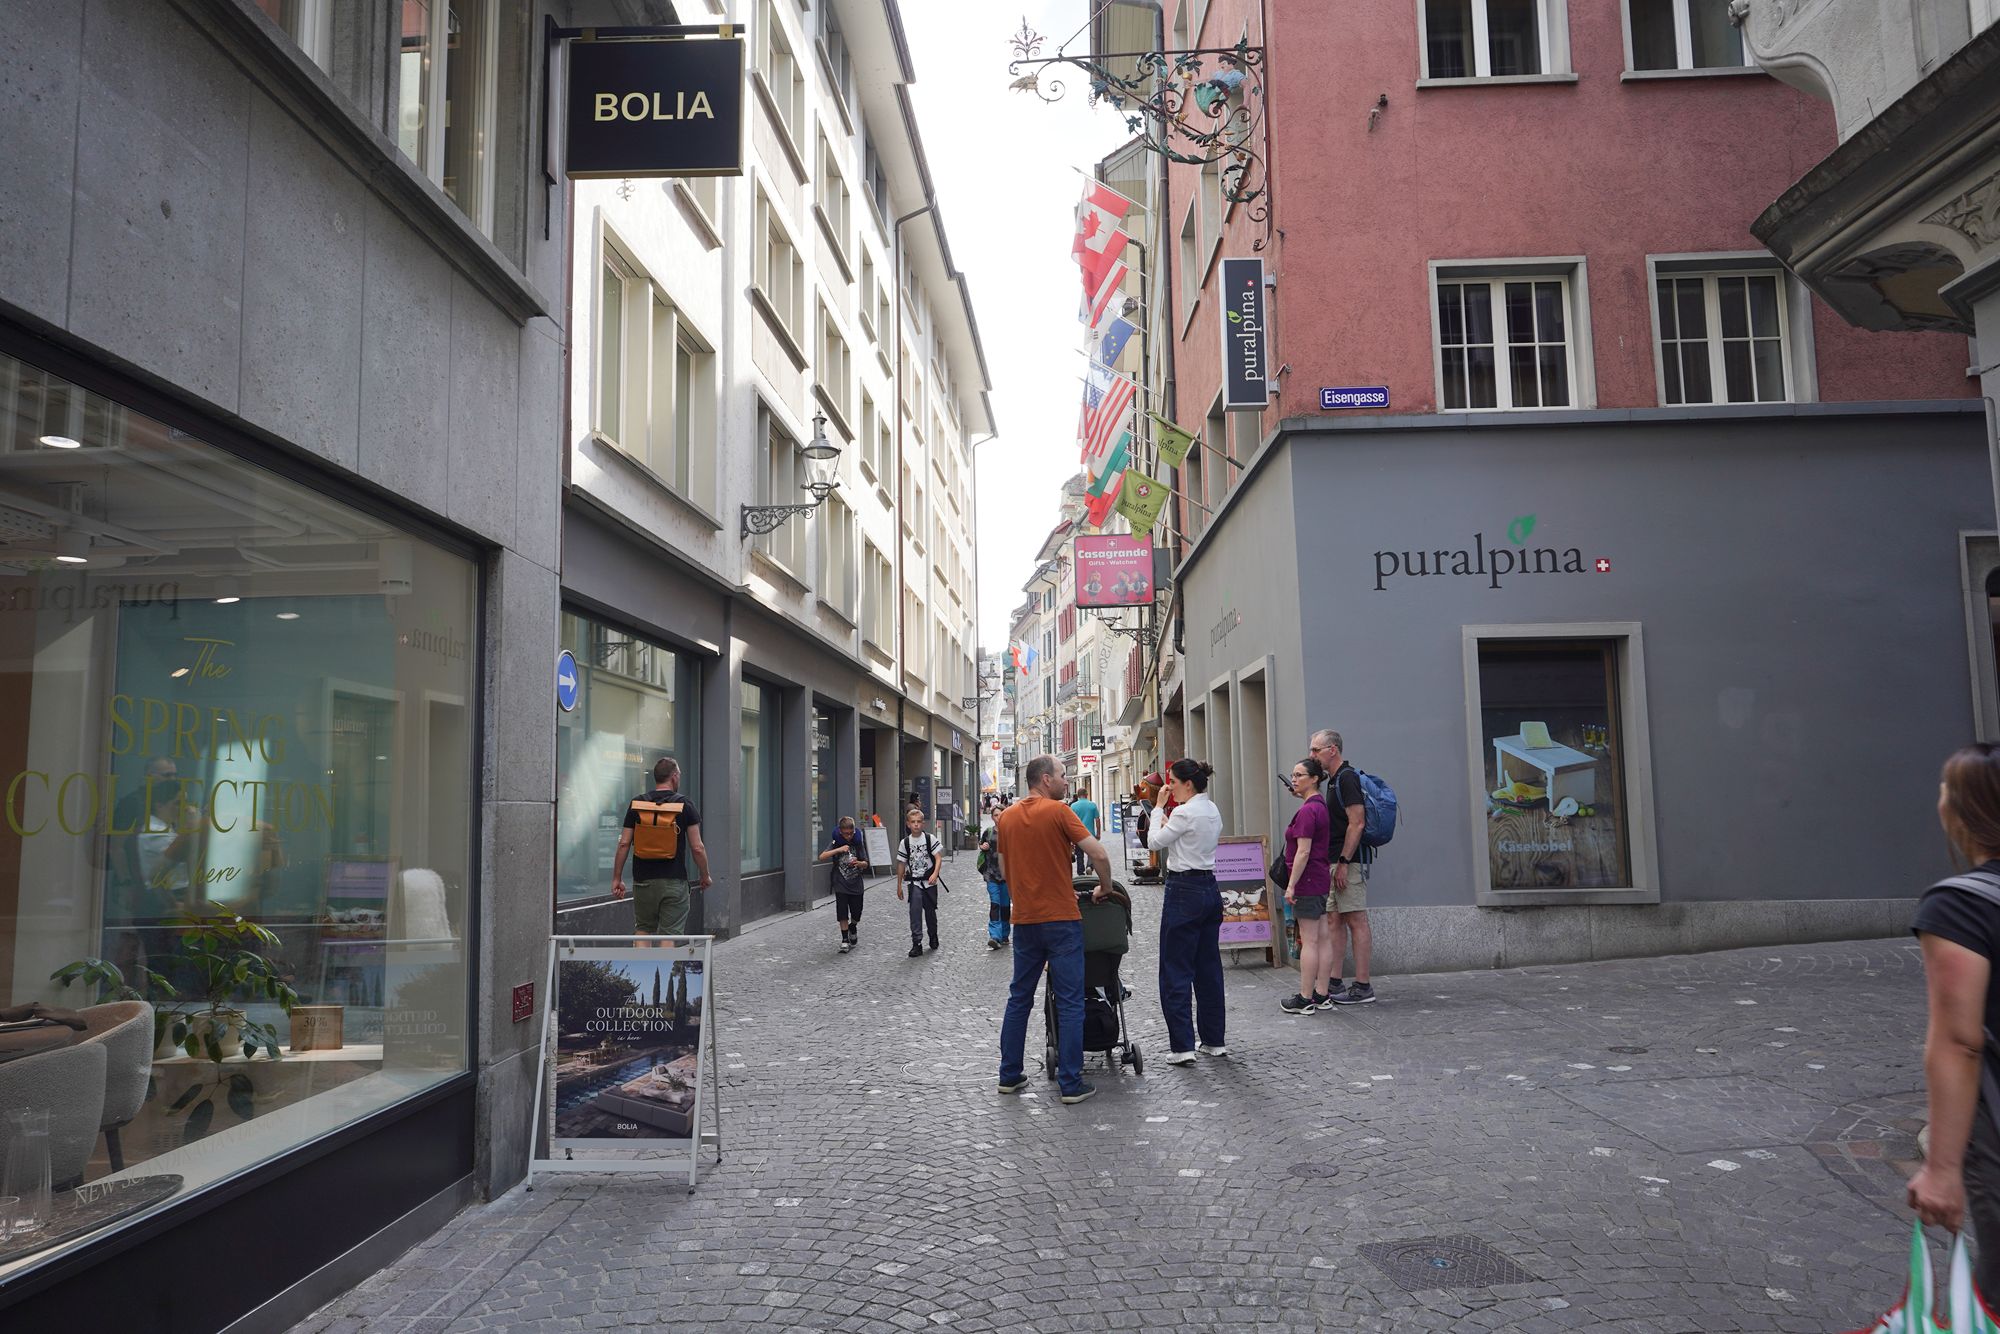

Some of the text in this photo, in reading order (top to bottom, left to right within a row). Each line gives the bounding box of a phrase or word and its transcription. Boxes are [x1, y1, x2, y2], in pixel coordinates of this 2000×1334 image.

[594, 91, 715, 122] BOLIA
[1236, 290, 1264, 382] puralpina
[1324, 390, 1385, 406] Eisengasse
[1121, 498, 1152, 518] puralpina
[1077, 548, 1149, 560] Casagrande
[1373, 532, 1587, 591] puralpina
[184, 637, 235, 686] The
[108, 694, 287, 766] SPRING
[5, 770, 337, 837] COLLECTION
[192, 850, 242, 889] here
[586, 1020, 674, 1032] COLLECTION
[596, 1007, 664, 1019] OUTDOOR
[627, 1033, 642, 1041] here
[74, 1179, 117, 1209] NEW
